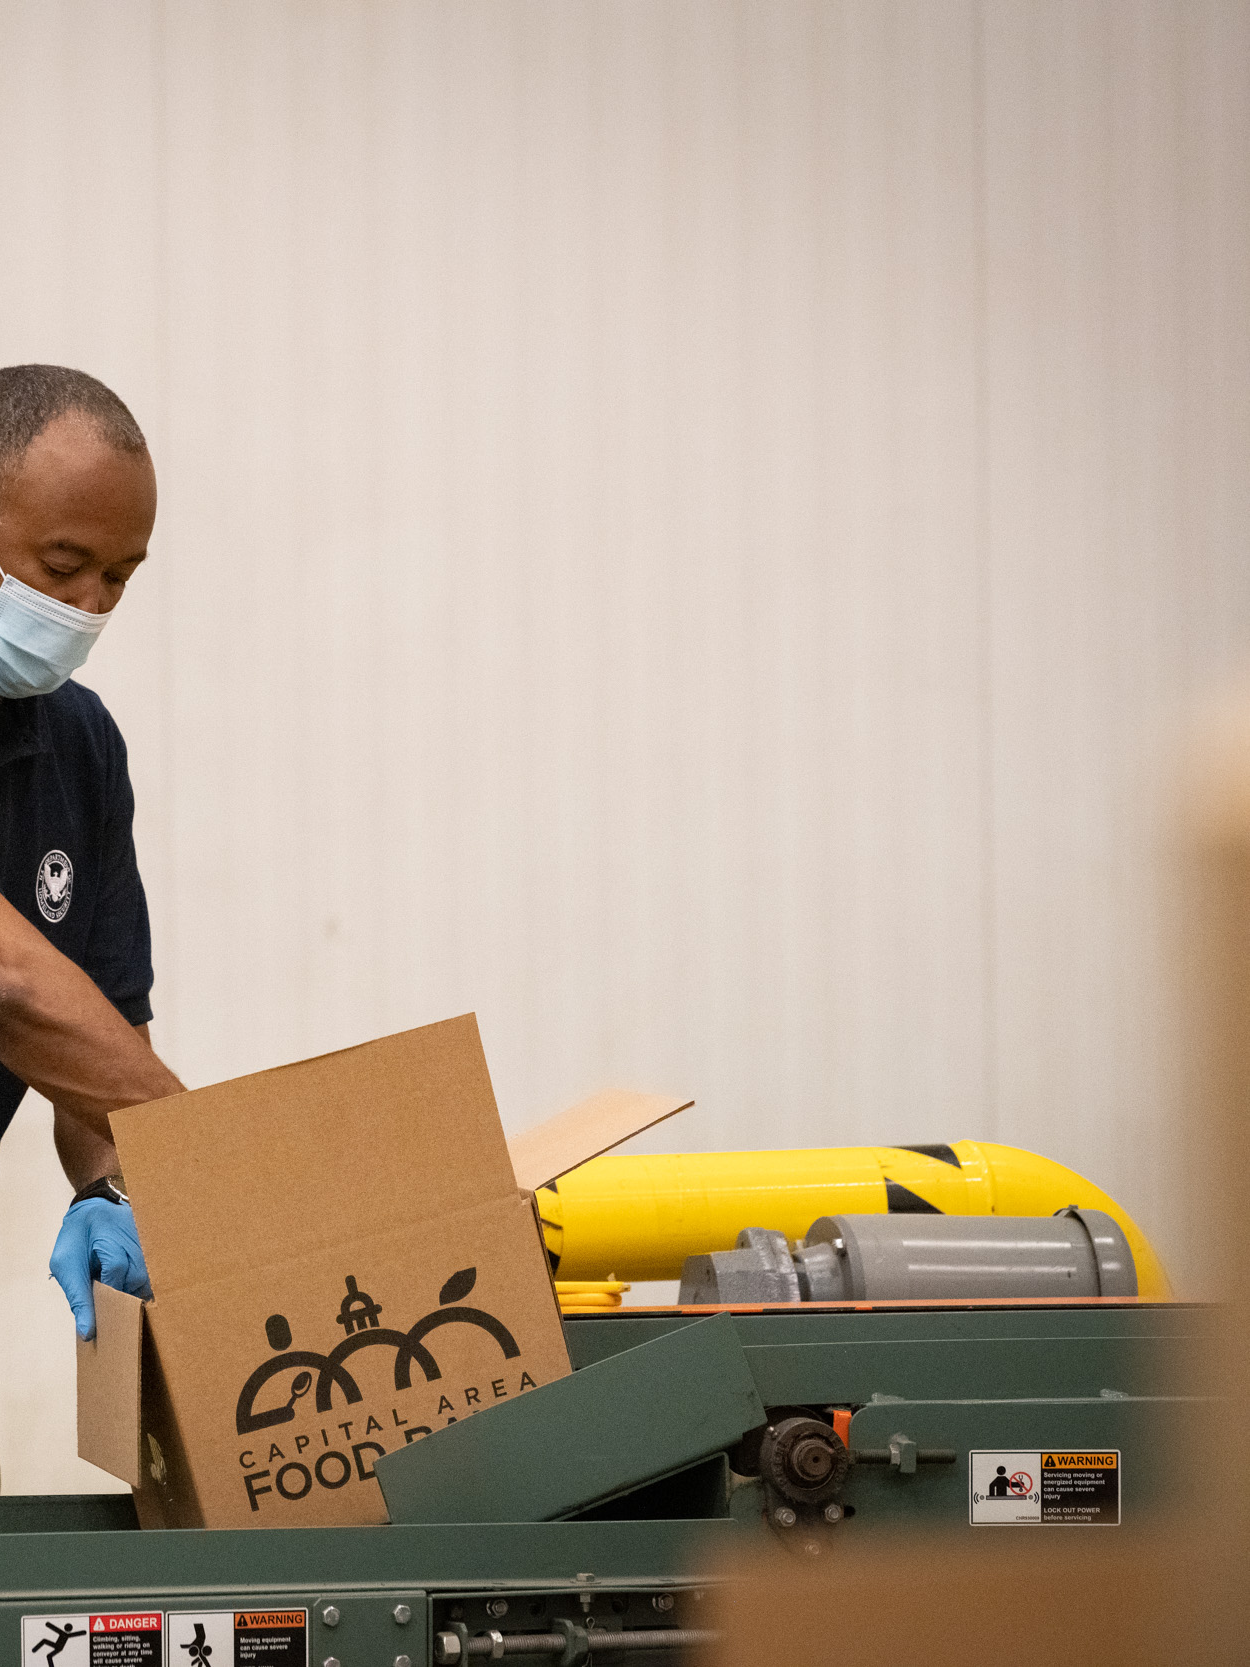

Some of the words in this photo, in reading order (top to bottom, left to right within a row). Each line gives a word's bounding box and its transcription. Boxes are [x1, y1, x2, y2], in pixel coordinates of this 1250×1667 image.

[239, 1408, 408, 1469] CAPITAL
[437, 1371, 538, 1415] AREA
[1057, 1456, 1114, 1466] WARNING
[243, 1441, 387, 1512] FOOD
[1043, 1471, 1072, 1479] Servicing
[109, 1617, 158, 1630] DANGER
[249, 1614, 303, 1625] WARNING
[261, 1636, 291, 1644] equipment
[124, 1642, 141, 1650] riding
[239, 1651, 257, 1659] injury
